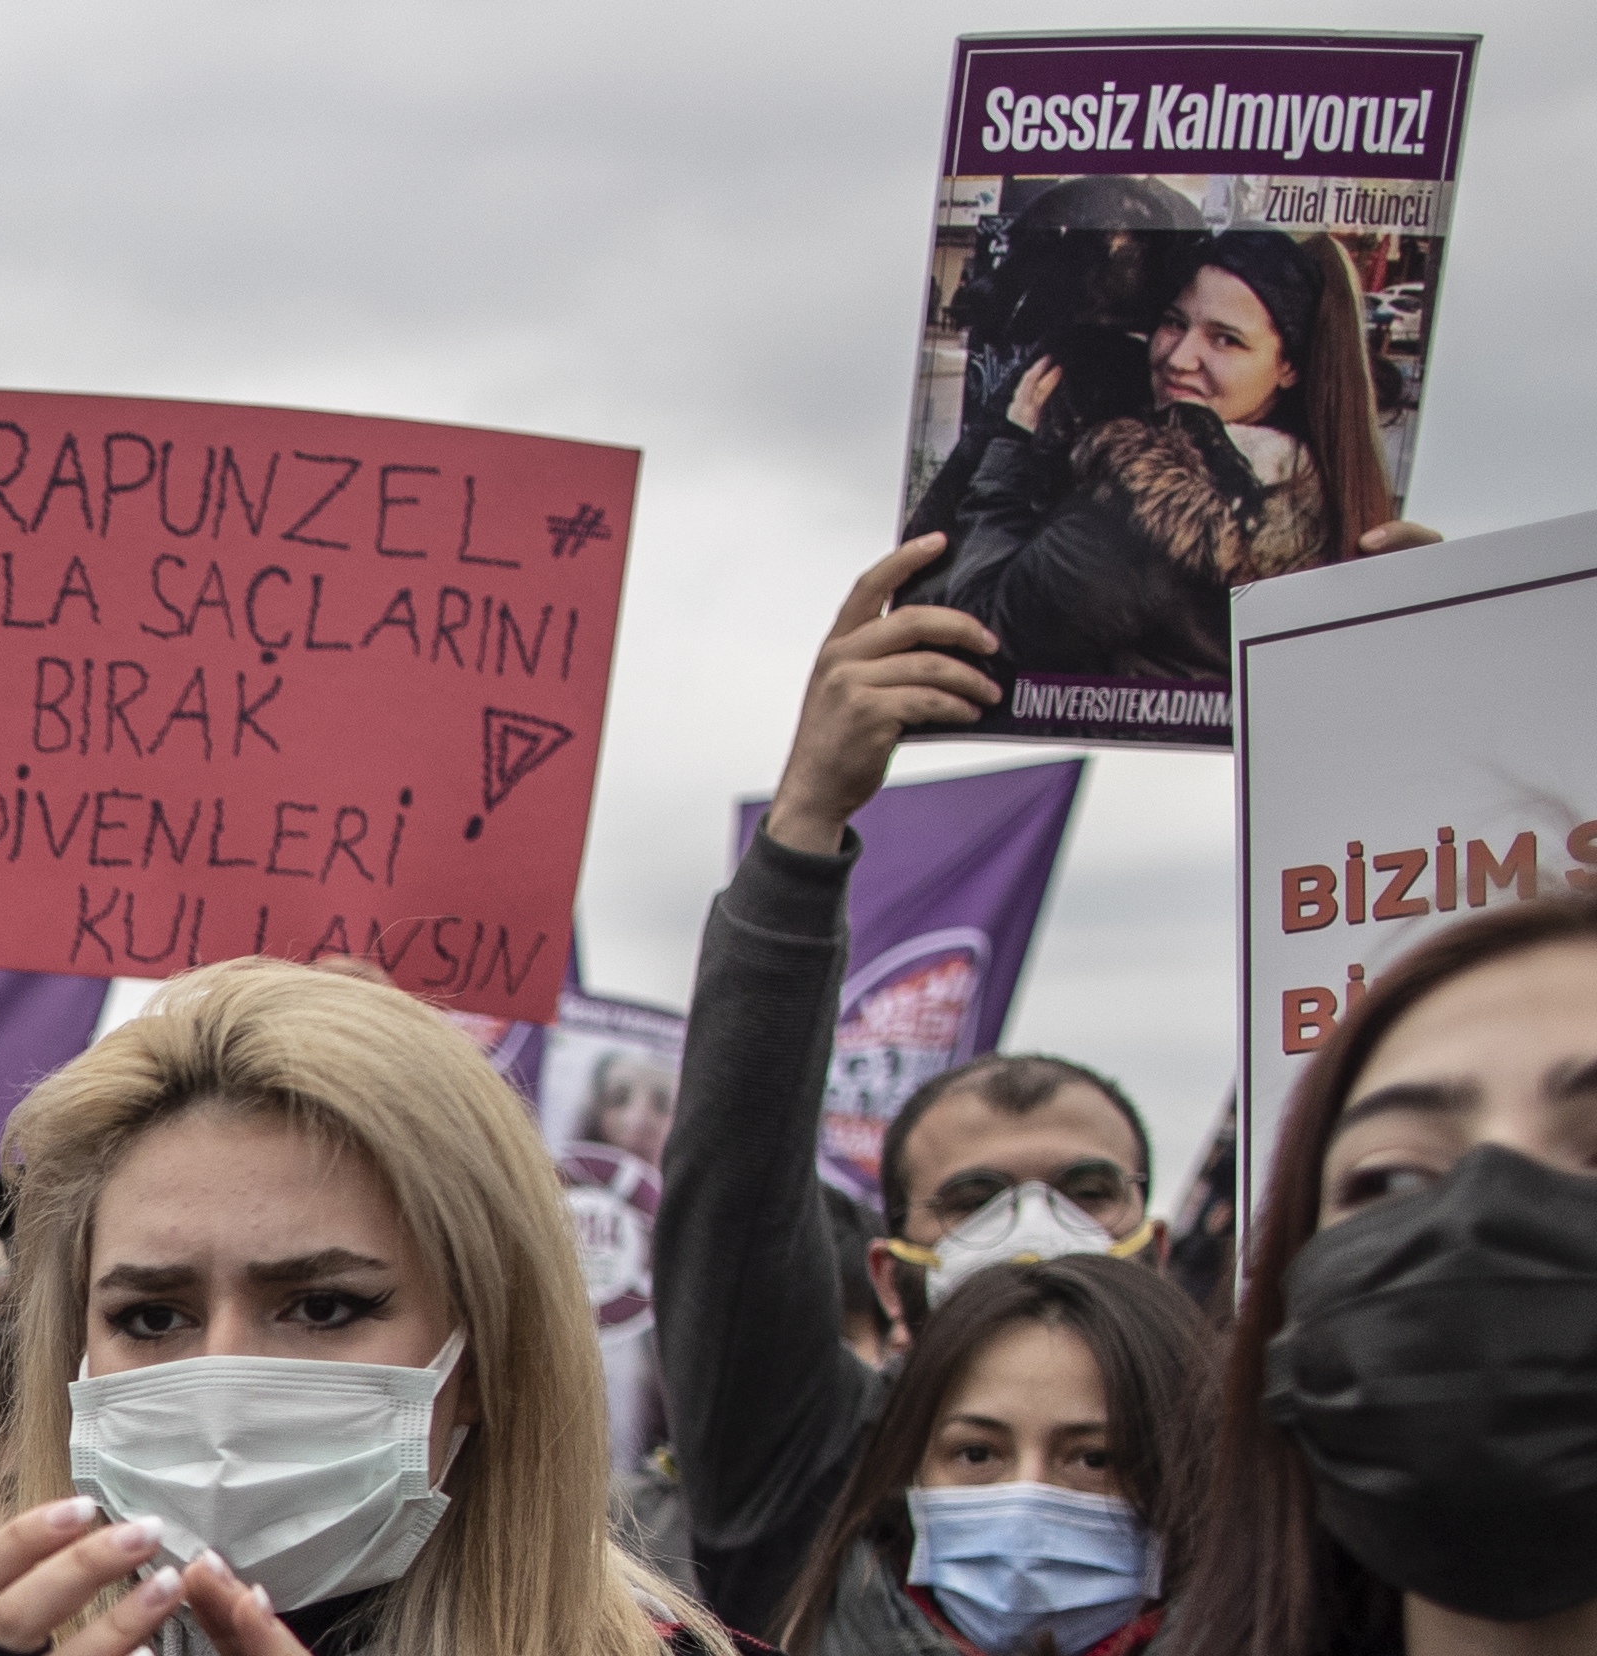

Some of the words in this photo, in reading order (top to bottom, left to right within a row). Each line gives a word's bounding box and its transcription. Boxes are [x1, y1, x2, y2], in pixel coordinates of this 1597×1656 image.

[981, 82, 1141, 153] Sessiz
[1142, 83, 1434, 162] Kalmıyoruz!
[1264, 184, 1330, 227] Zülal
[1332, 184, 1433, 230] Tütüncü
[139, 551, 580, 681] SAÇLARINI
[31, 654, 285, 760] BIRAK
[1281, 826, 1538, 935] BİZİM
